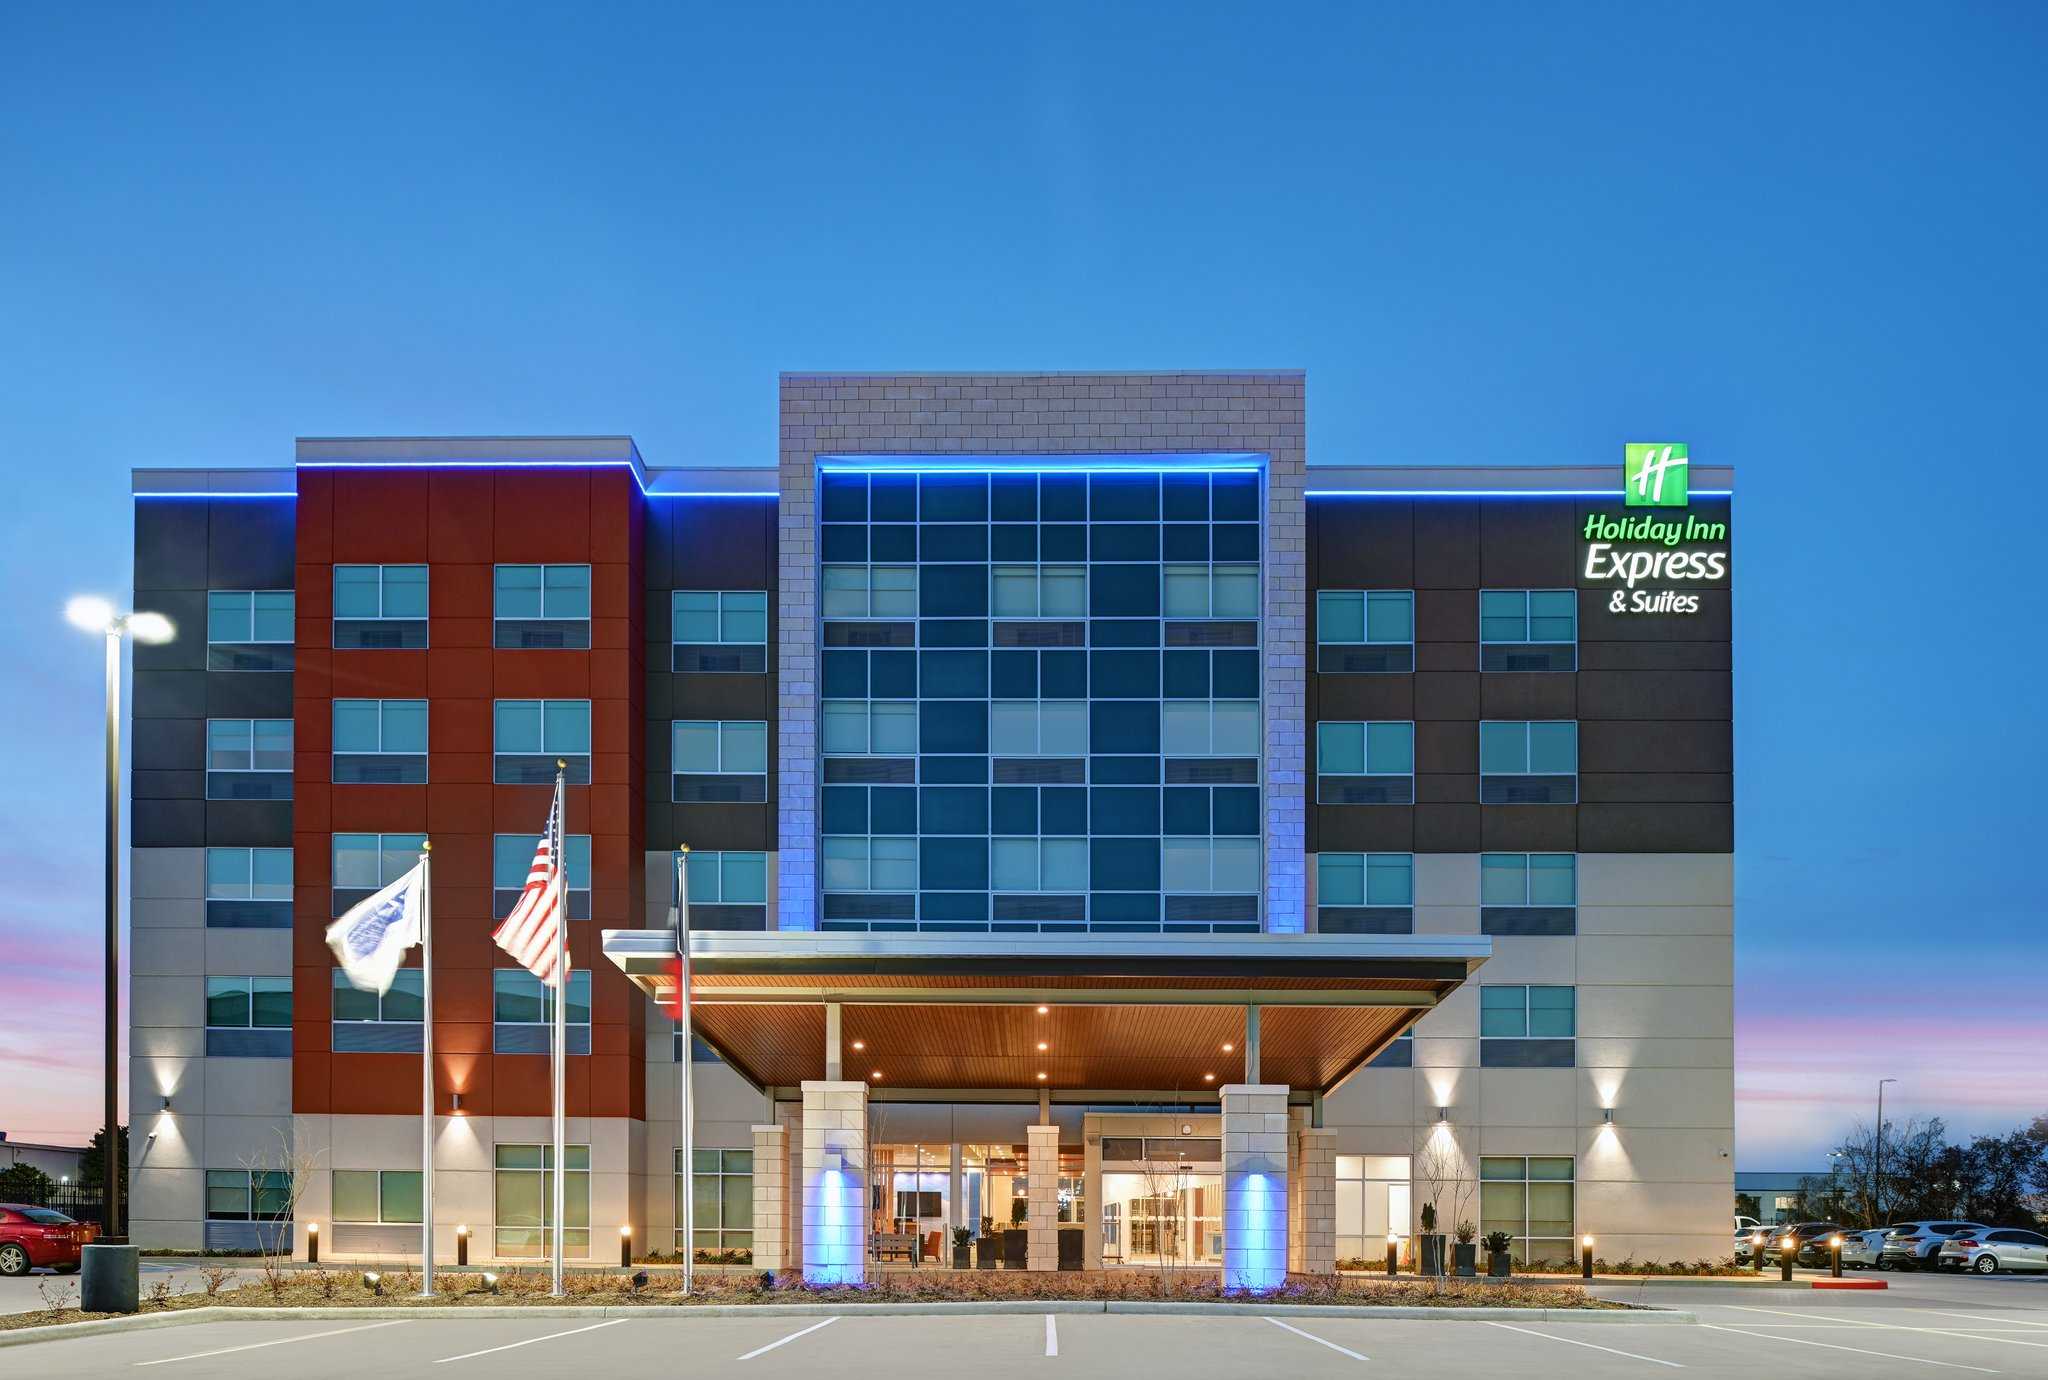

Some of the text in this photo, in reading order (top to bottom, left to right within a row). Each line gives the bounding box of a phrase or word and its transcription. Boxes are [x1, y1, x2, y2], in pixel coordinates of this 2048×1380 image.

[1631, 446, 1688, 502] H
[1584, 514, 1726, 545] Holiday Inn
[1584, 543, 1727, 588] Express
[1609, 590, 1699, 613] & Suites
